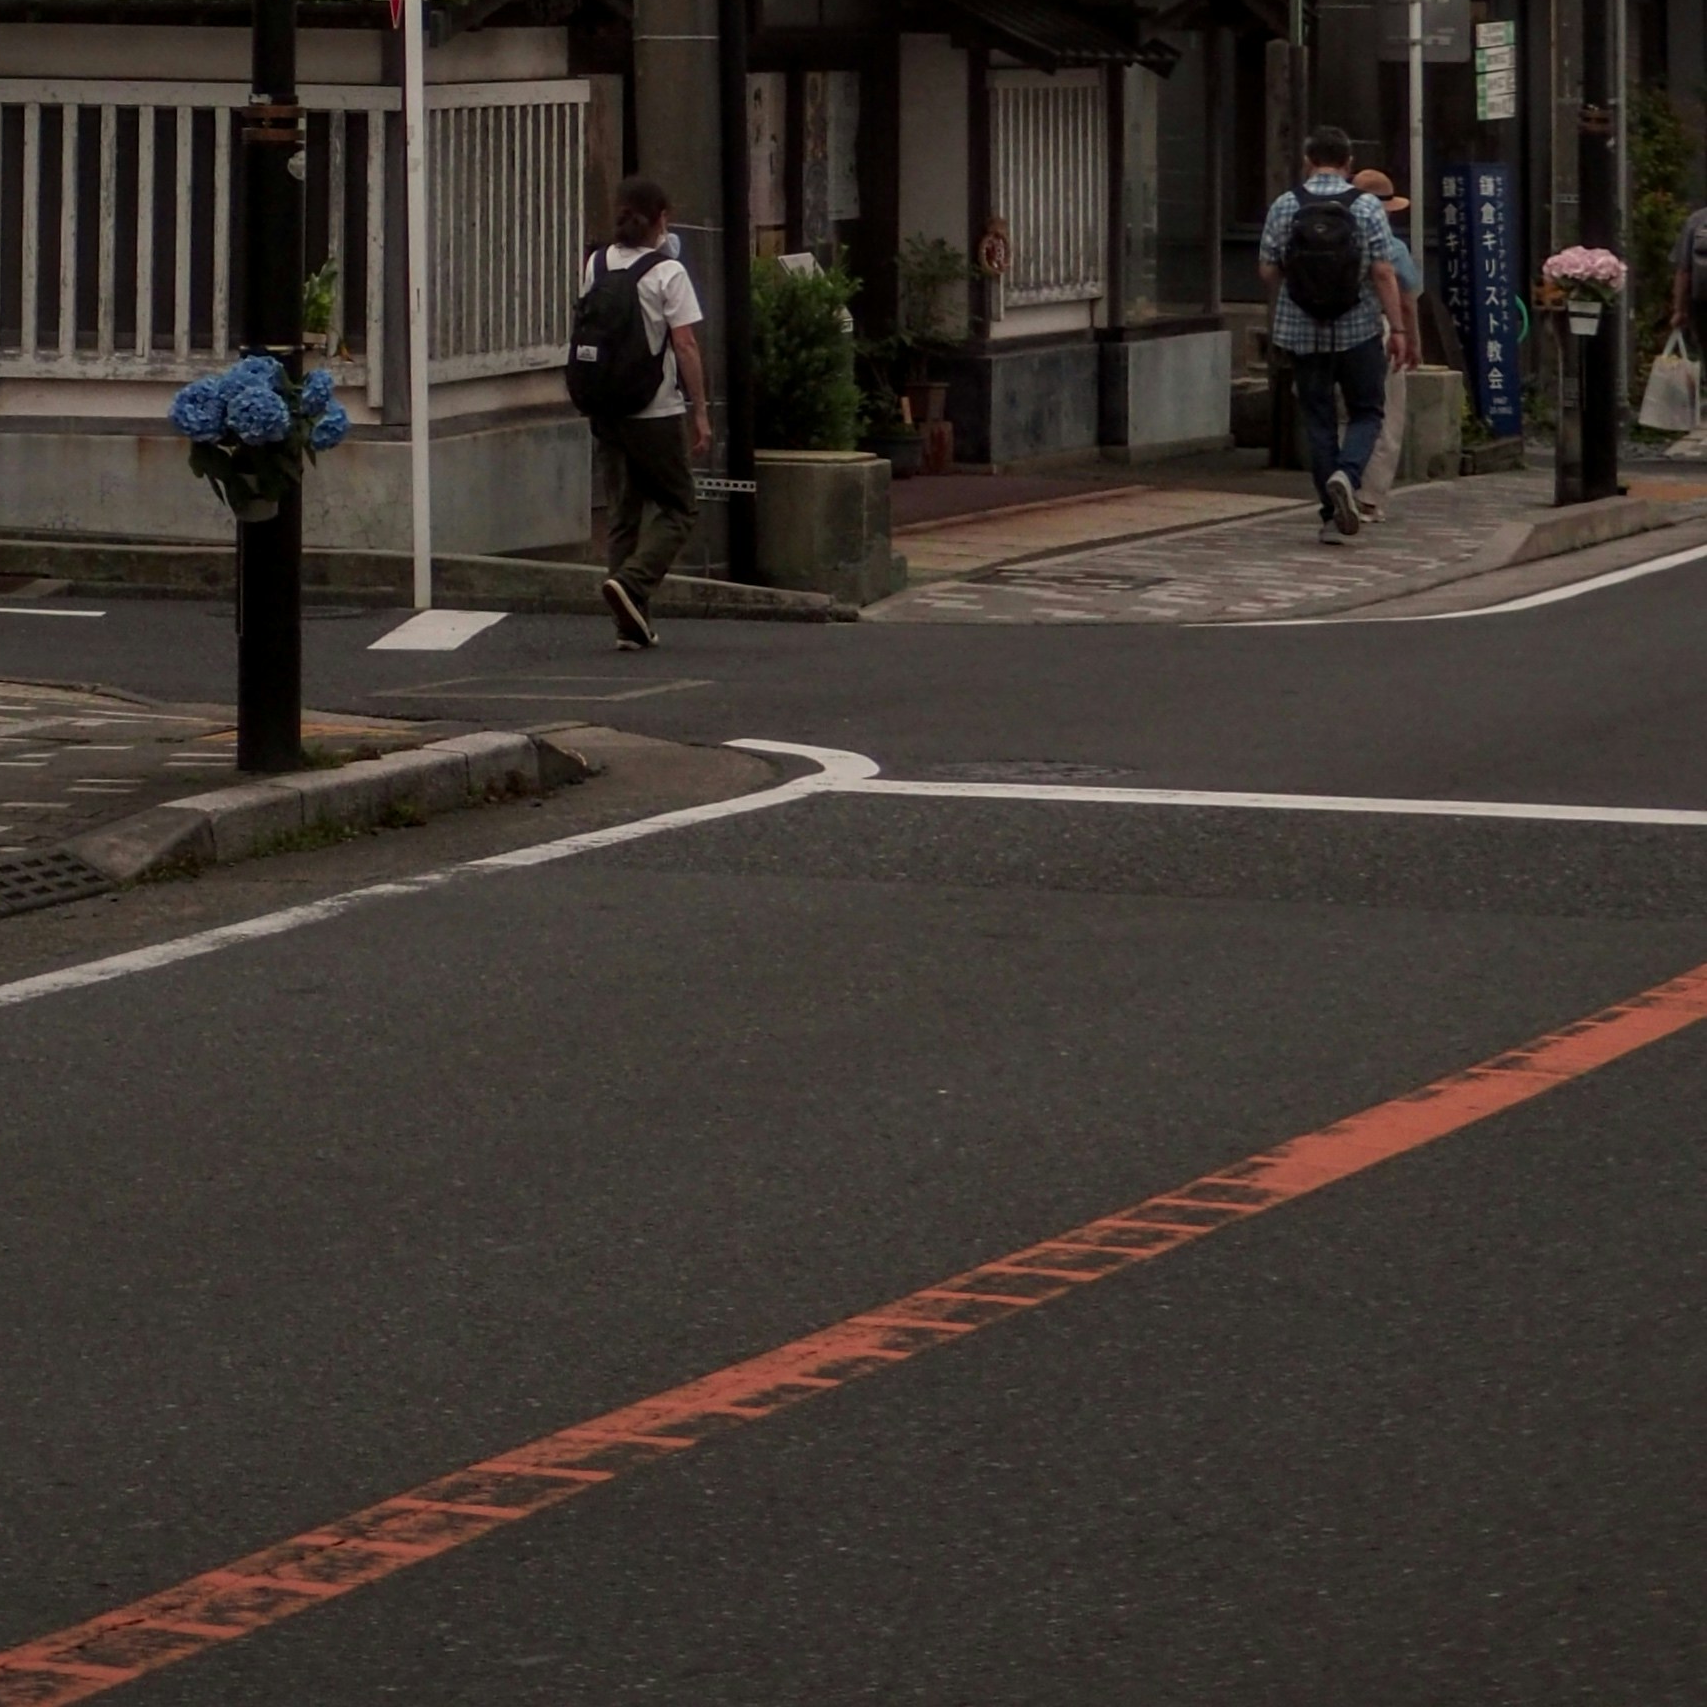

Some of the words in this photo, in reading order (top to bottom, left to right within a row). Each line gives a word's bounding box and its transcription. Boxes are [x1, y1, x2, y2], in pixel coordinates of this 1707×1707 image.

[1479, 175, 1504, 390] 鎌倉キリスト教会
